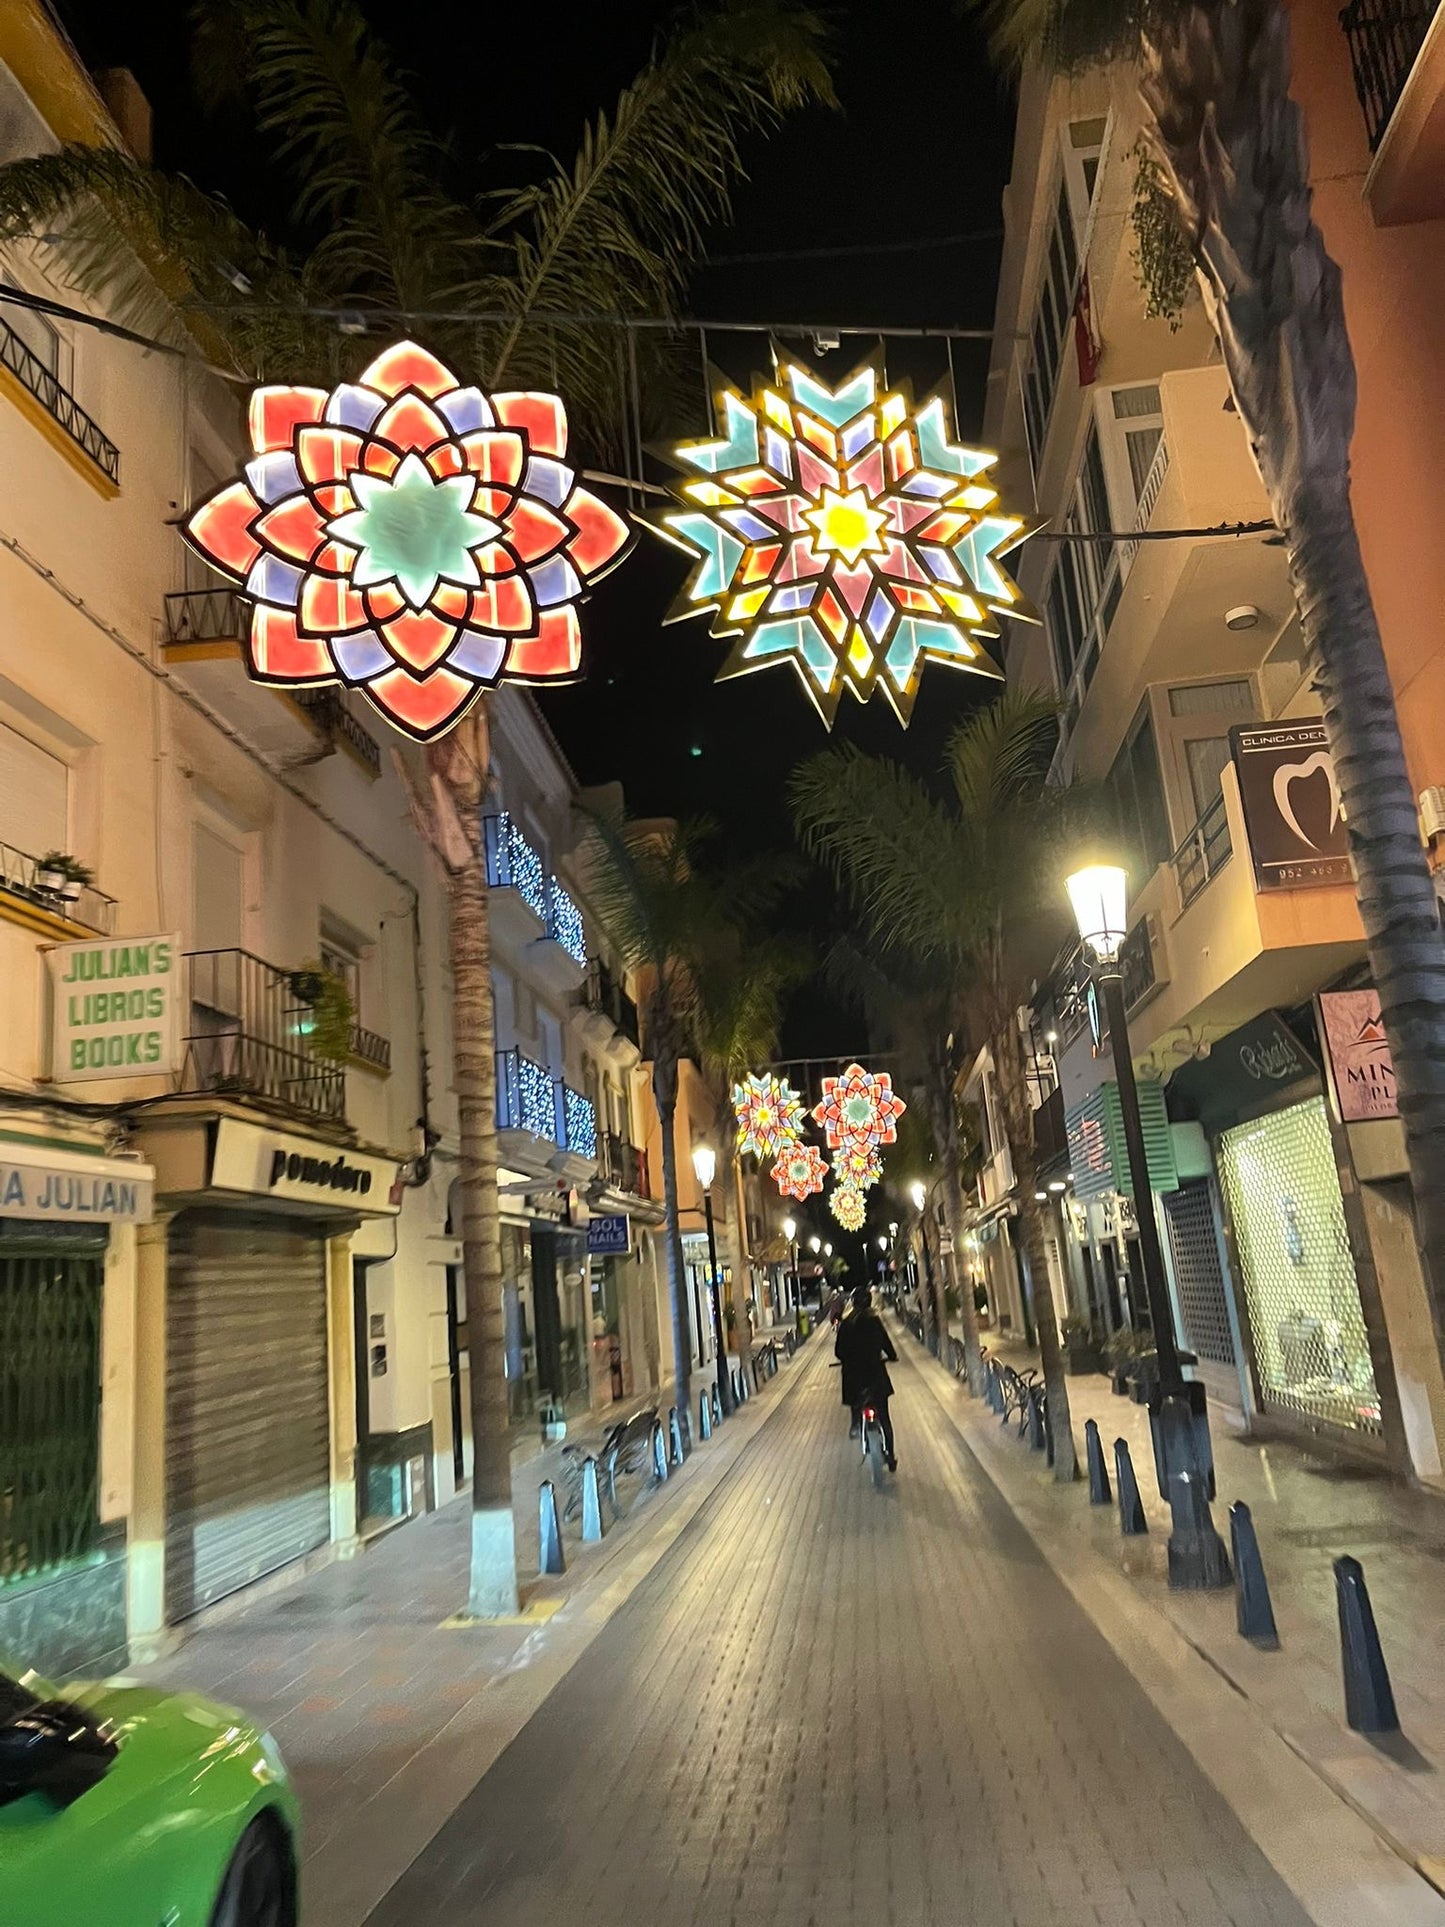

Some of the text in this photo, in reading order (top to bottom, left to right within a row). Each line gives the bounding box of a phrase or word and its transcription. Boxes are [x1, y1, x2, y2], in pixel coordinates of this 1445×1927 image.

[1242, 735, 1294, 746] CLINICA
[62, 941, 172, 983] JULIAN'S
[68, 986, 165, 1027] LIBROS
[71, 1031, 161, 1071] BOOKS
[37, 1175, 136, 1215] JULIAN
[591, 1218, 623, 1234] SOL
